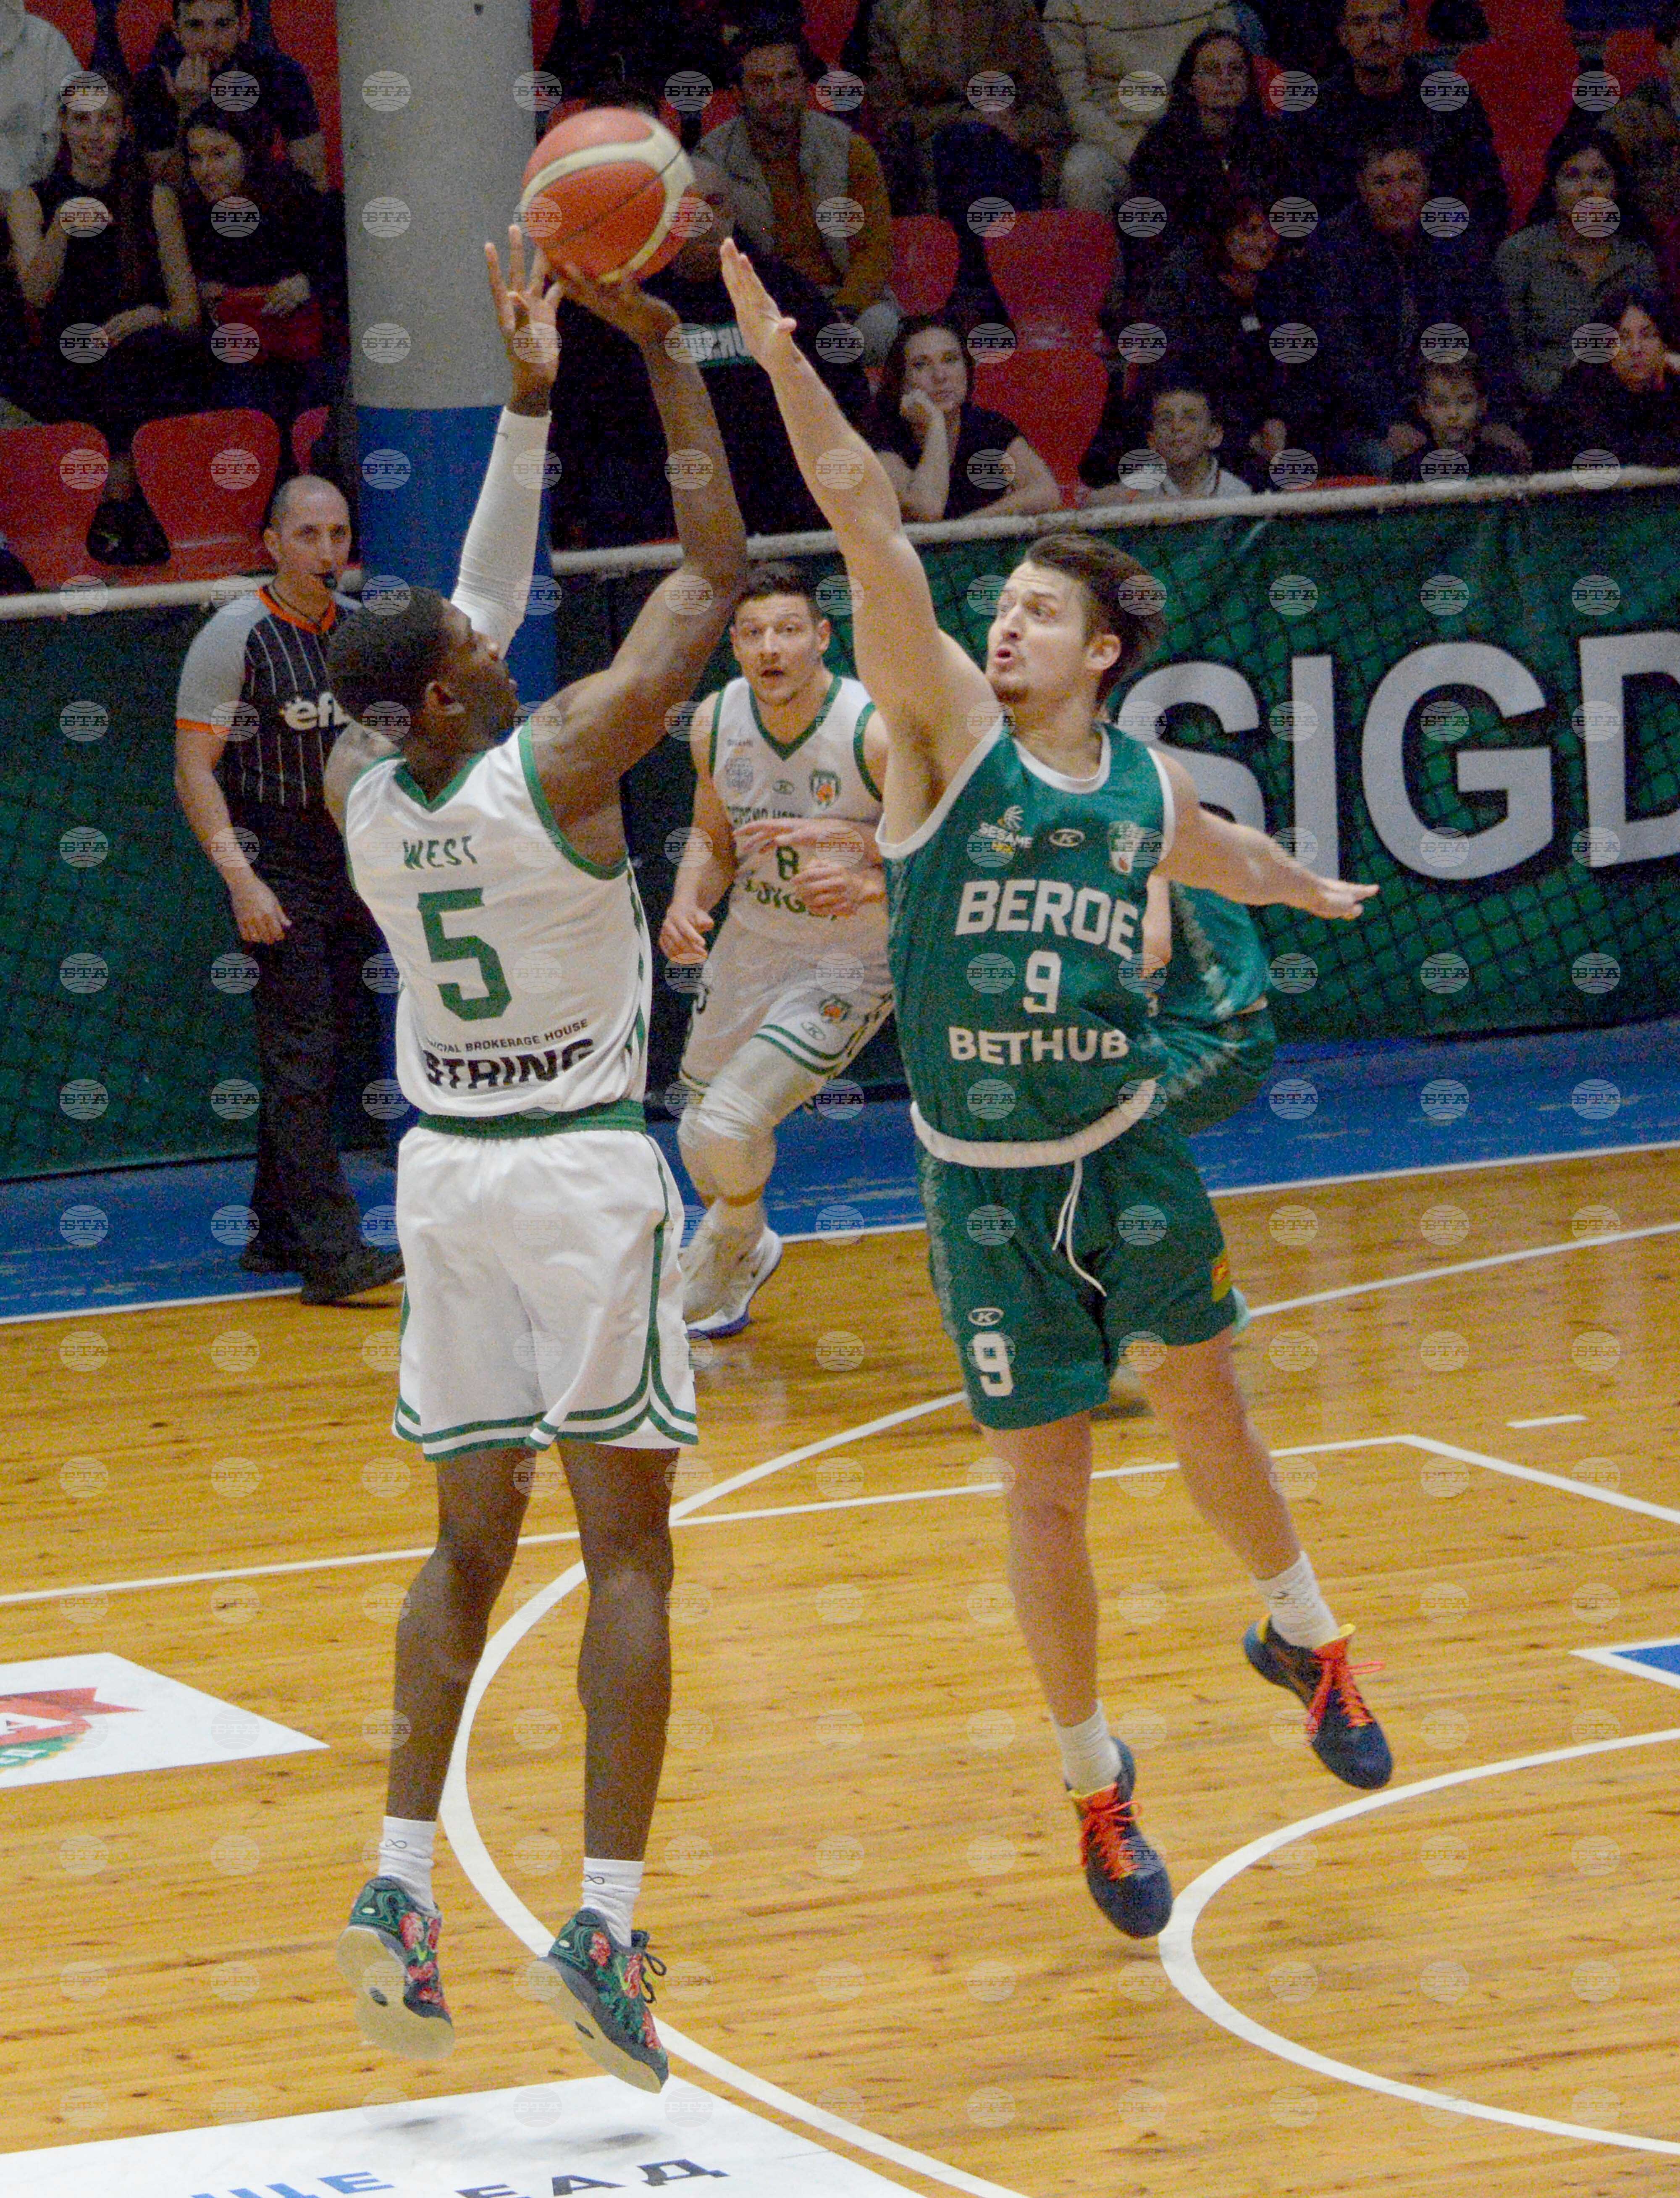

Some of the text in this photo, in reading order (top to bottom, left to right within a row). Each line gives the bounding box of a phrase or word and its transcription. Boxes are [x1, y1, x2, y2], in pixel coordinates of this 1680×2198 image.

[403, 835, 478, 869] WEST
[776, 846, 800, 881] 8
[955, 878, 1138, 960] BEROE
[417, 887, 512, 1021] 5
[1022, 950, 1061, 1014] 9
[465, 1036, 541, 1052] BROKERAGE
[544, 1018, 589, 1041] HOUSE
[948, 1027, 1129, 1065] BETHUB
[423, 1038, 594, 1089] STRING
[973, 1332, 1014, 1397] 9
